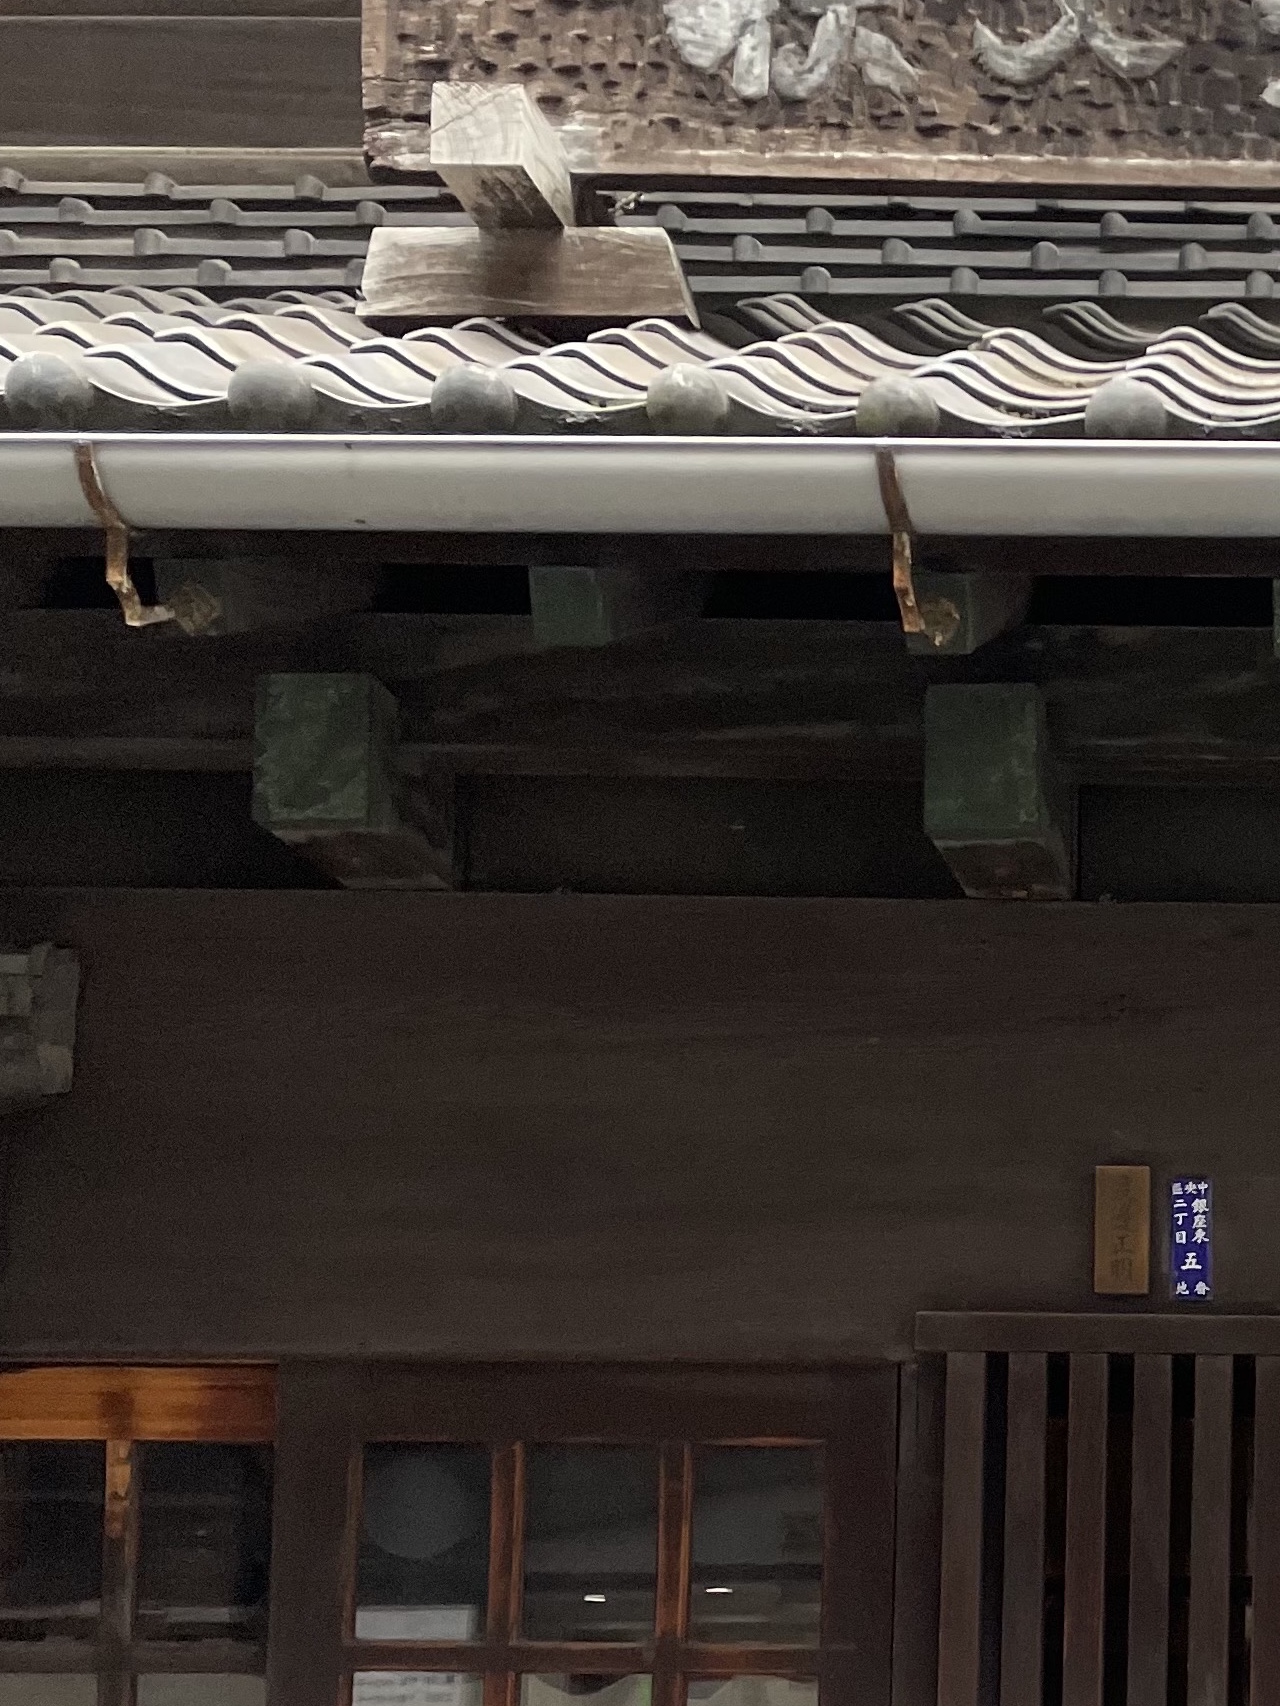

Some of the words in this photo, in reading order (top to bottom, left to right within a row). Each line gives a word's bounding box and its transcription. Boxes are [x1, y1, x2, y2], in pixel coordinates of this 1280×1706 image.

[1173, 1199, 1188, 1244] 二丁目
[1180, 1252, 1202, 1270] 五
